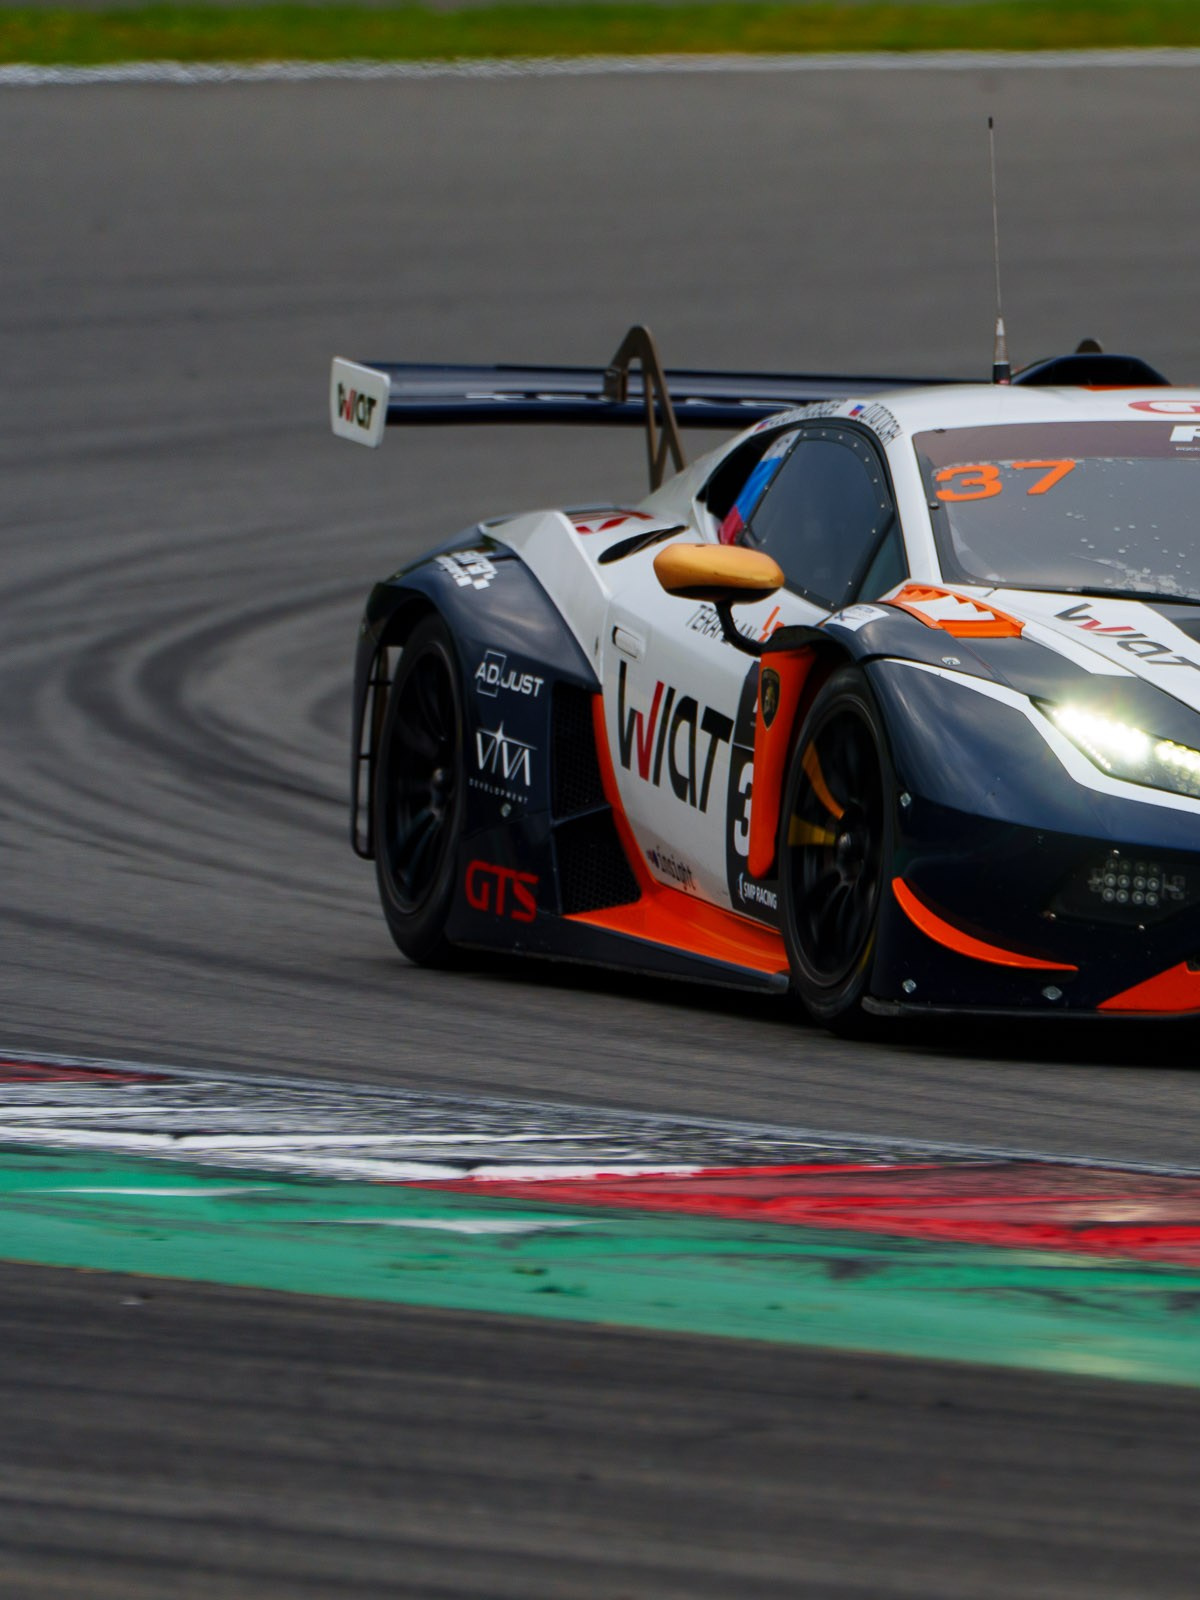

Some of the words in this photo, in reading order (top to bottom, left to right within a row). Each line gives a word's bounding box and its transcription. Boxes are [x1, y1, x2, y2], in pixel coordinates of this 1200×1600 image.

[935, 460, 1076, 502] 37
[475, 729, 533, 788] VIVA
[468, 777, 529, 804] DEVELOPMENT
[465, 860, 540, 923] GTS
[743, 881, 757, 901] SMP
[756, 885, 778, 910] RACING
